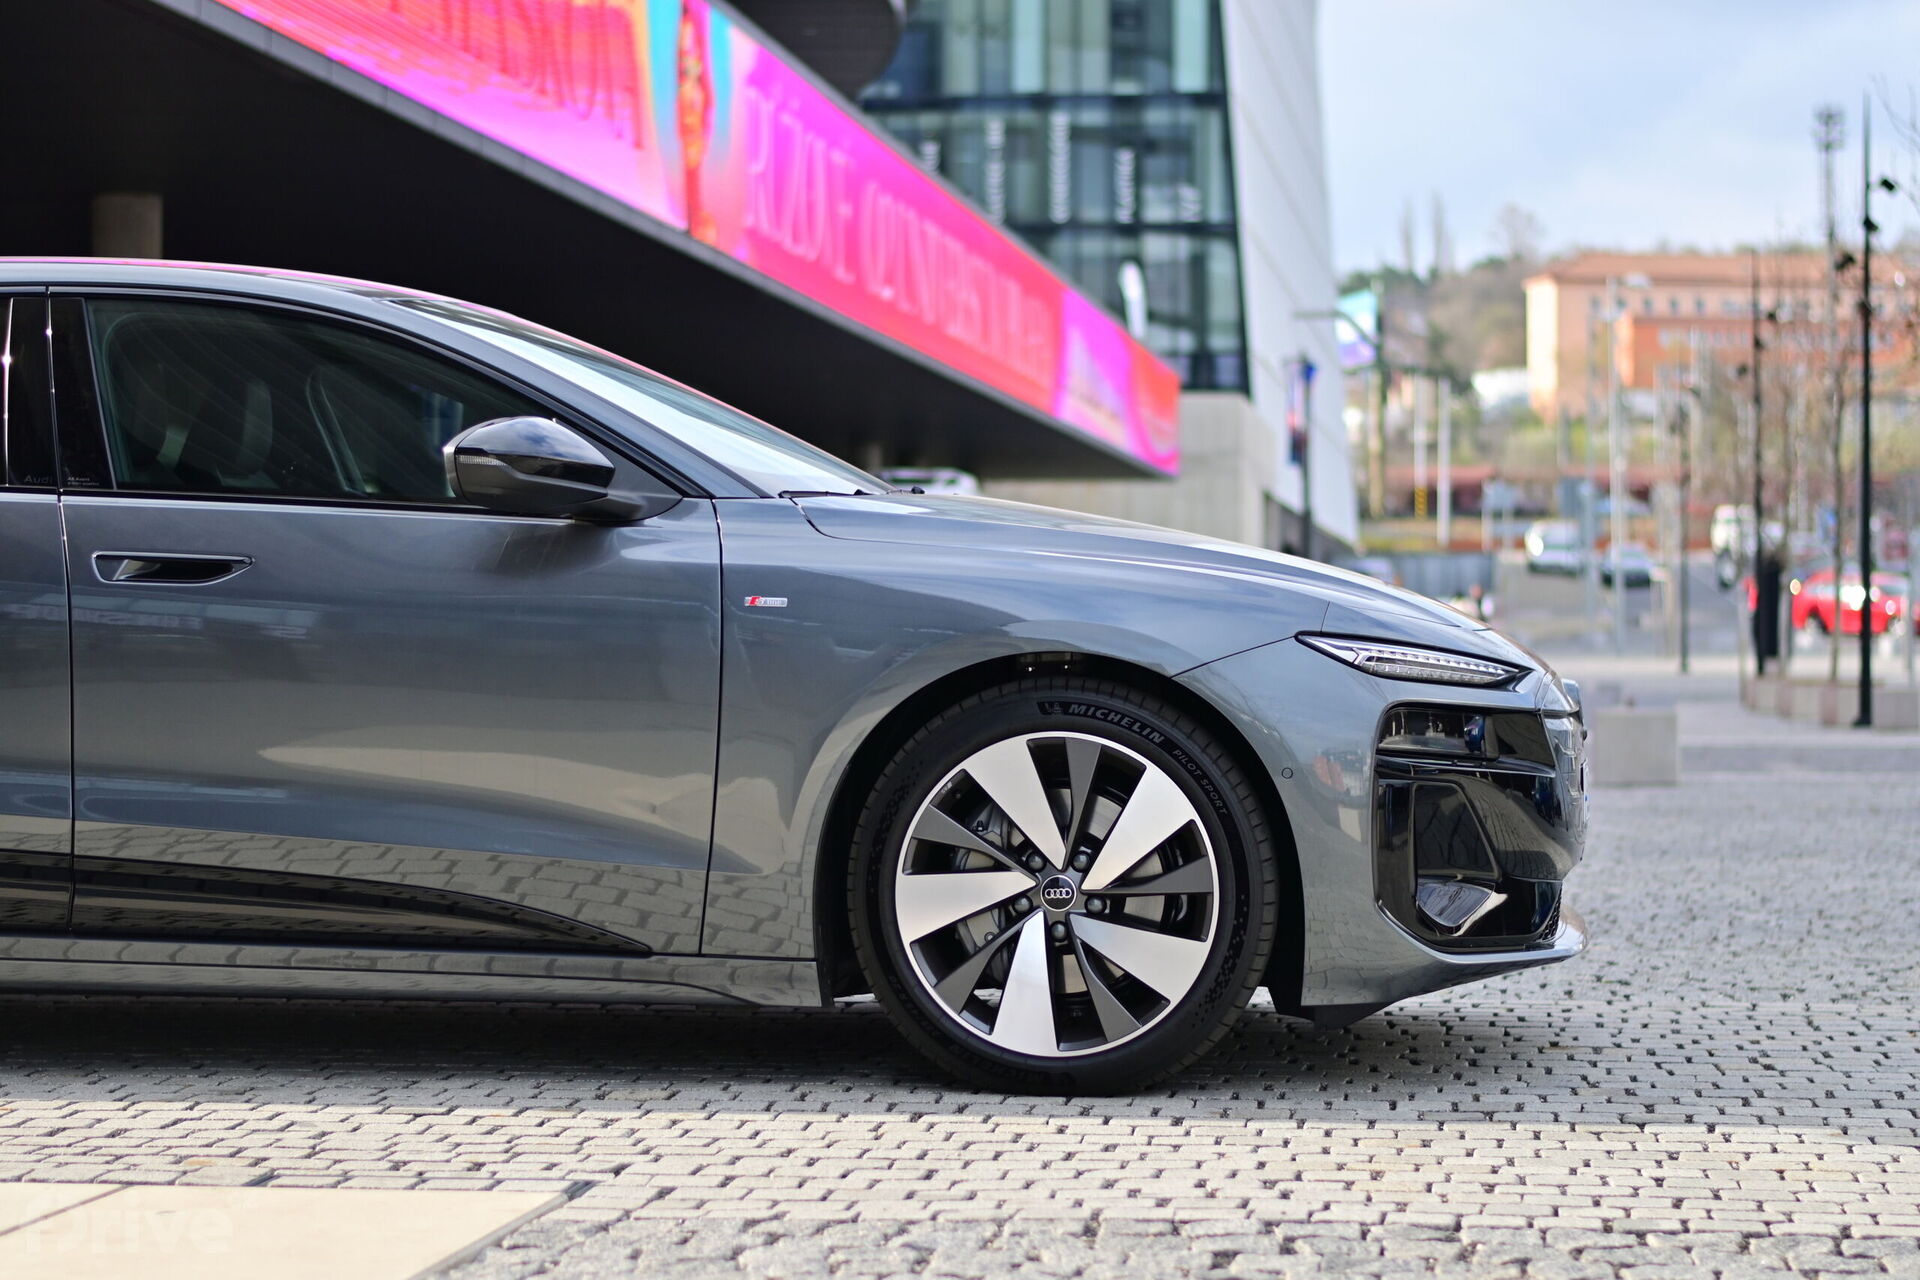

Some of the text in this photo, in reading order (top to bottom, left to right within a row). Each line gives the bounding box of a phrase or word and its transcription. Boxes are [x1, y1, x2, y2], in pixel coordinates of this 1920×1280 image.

[1069, 704, 1228, 815] MICHELIN PILOT SPORT
